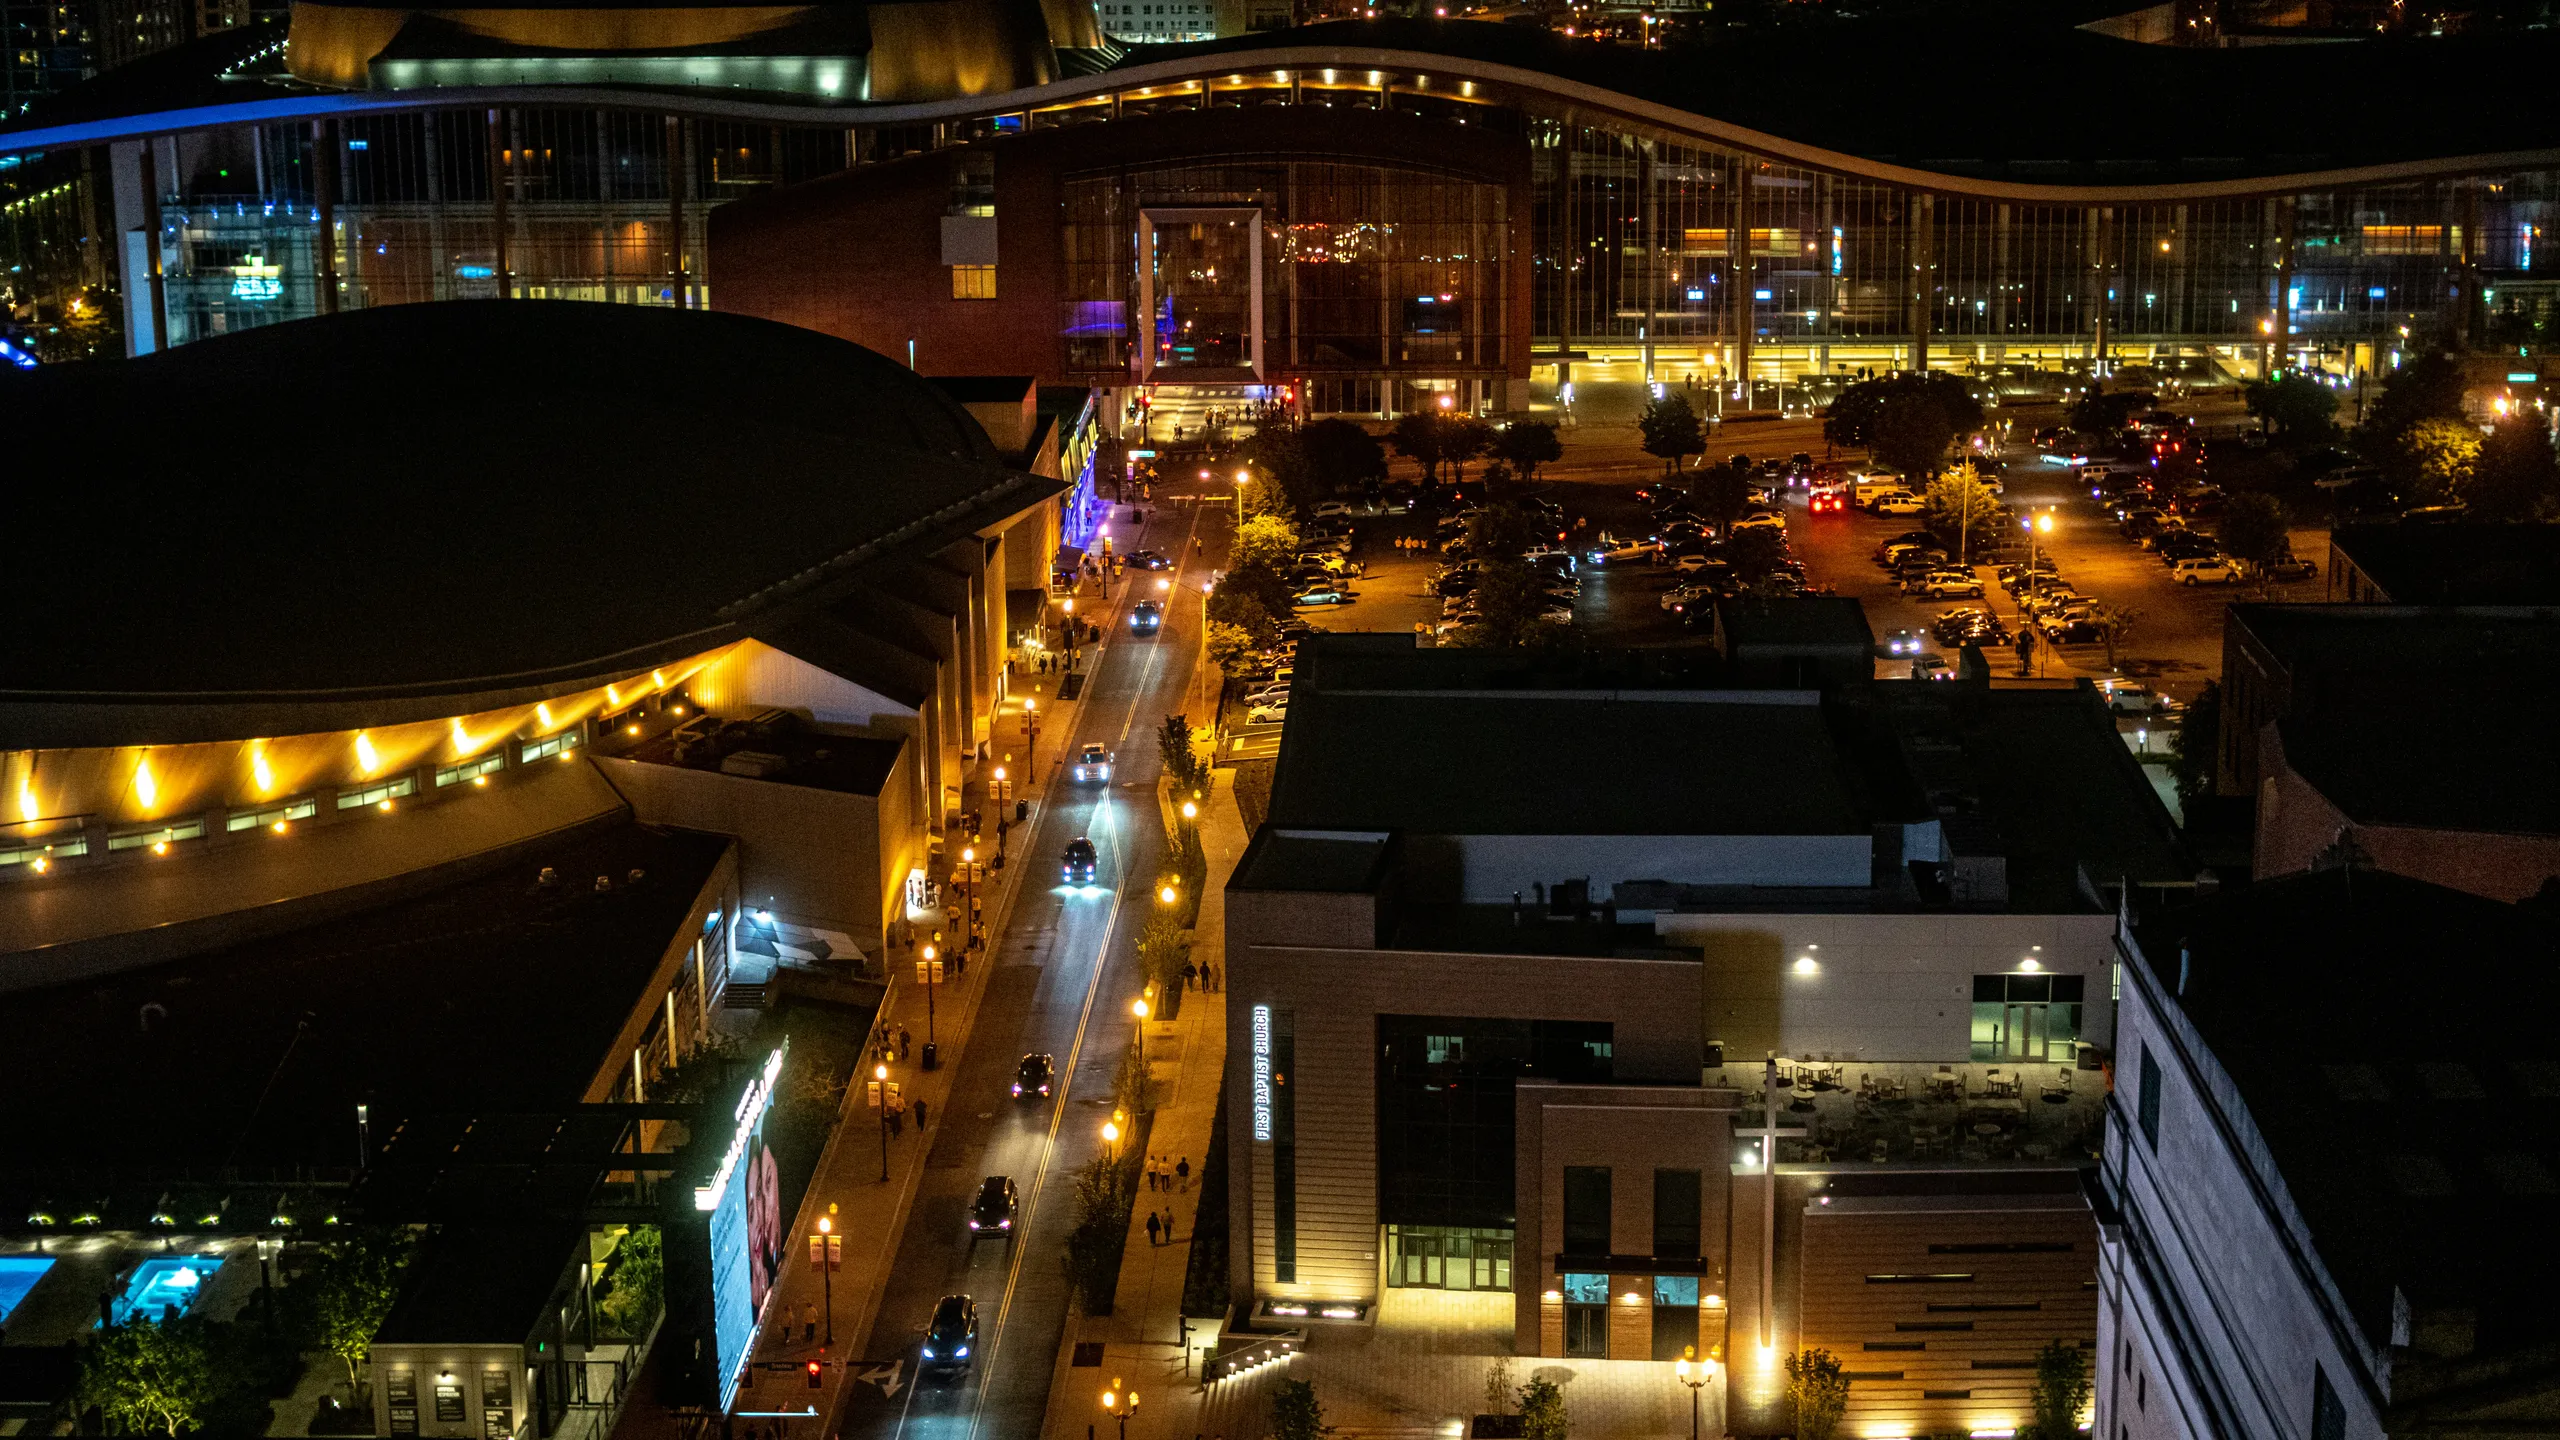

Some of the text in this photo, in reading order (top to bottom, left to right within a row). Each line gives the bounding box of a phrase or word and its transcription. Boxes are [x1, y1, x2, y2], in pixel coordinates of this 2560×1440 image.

[1255, 1008, 1268, 1139] FIRST BAPTIST CHURCH
